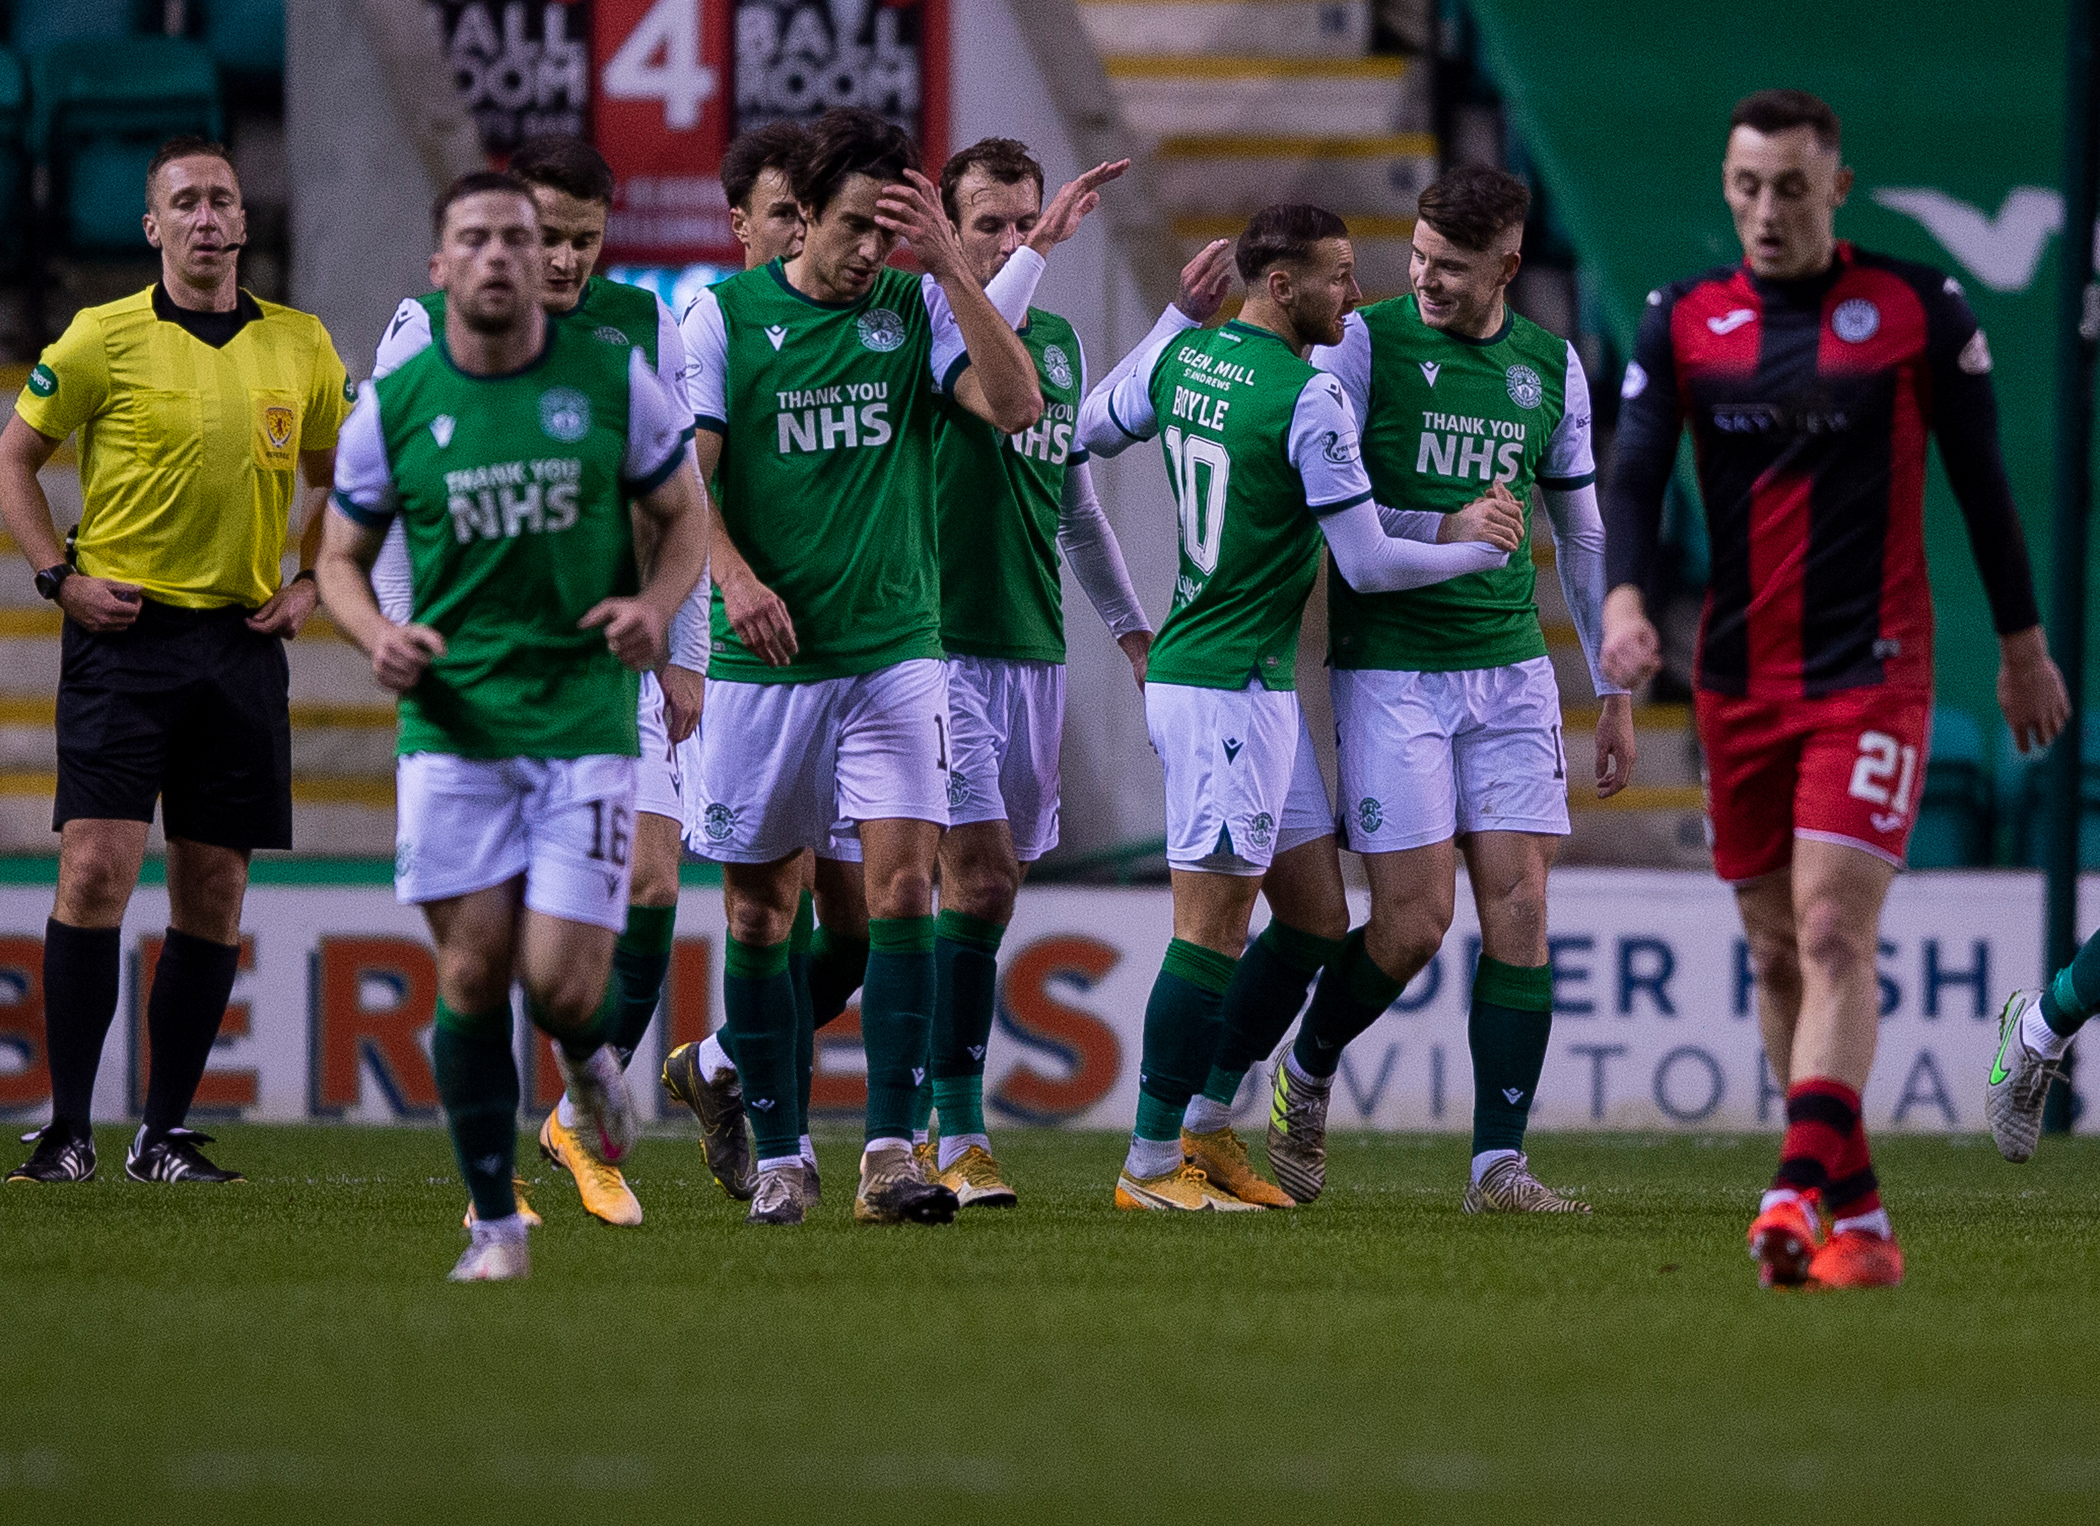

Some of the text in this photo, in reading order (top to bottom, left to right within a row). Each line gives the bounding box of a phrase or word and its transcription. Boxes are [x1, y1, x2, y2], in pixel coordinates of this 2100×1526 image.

[436, 3, 582, 58] ALL
[445, 54, 584, 109] OOM
[602, 0, 717, 131] 4
[776, 381, 888, 409] THANK YOU
[1047, 402, 1074, 422] YOU
[1172, 385, 1230, 432] BOYLE
[776, 402, 893, 455] NHS
[1422, 411, 1526, 442] THANK YOU
[444, 457, 582, 496] THANK YOU
[1416, 431, 1524, 484] NHS
[447, 483, 582, 545] NHS
[1164, 424, 1230, 577] 10
[935, 714, 948, 771] 1
[1551, 724, 1565, 780] 1
[1848, 729, 1917, 814] 21
[583, 799, 629, 867] 16
